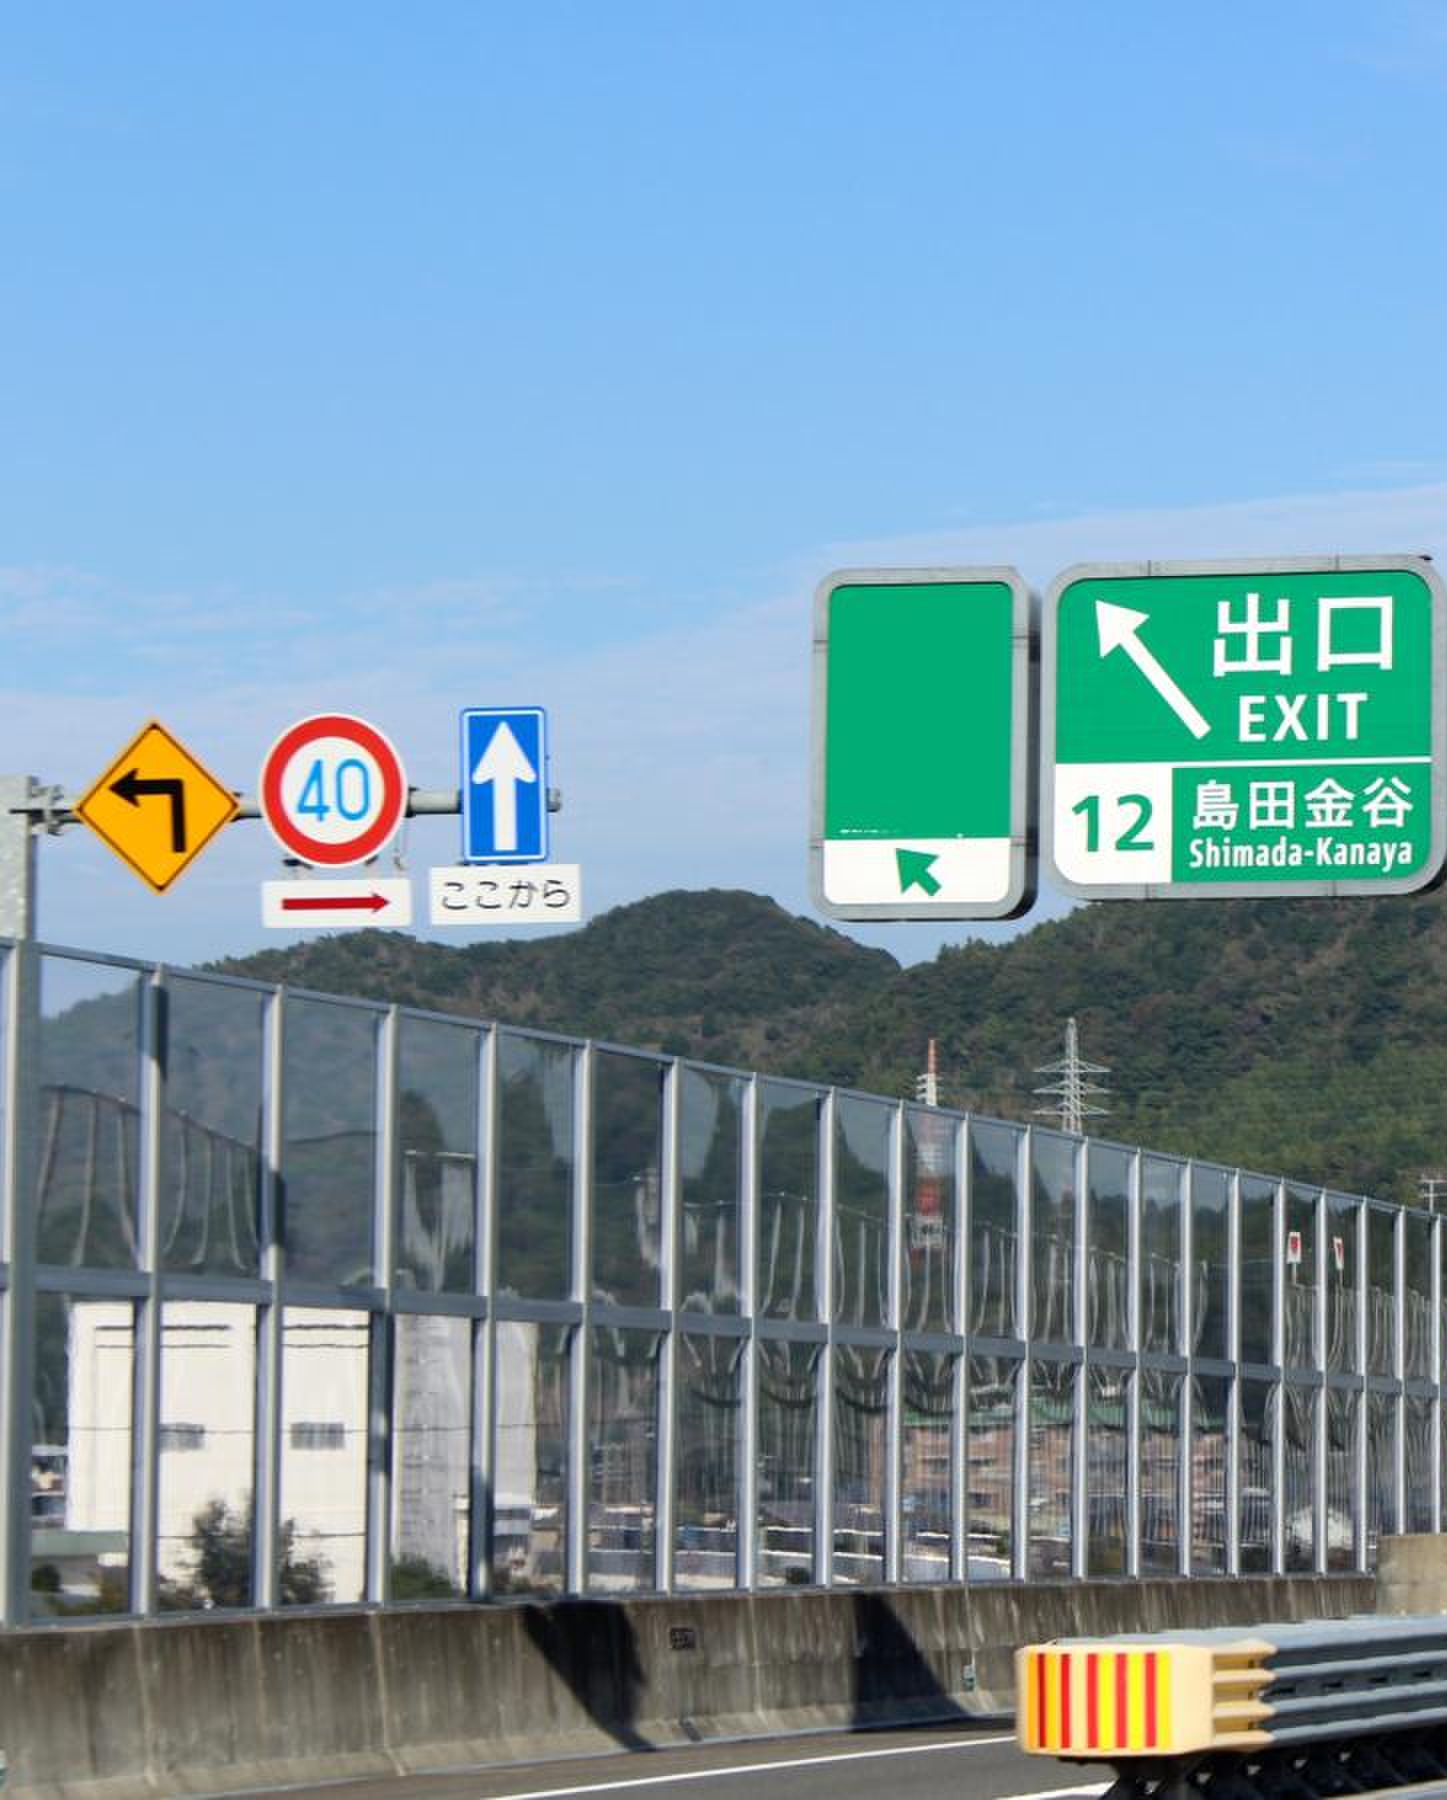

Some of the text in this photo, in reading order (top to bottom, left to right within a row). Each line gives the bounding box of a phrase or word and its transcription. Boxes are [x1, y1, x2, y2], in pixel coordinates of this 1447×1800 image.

[1214, 593, 1393, 677] 出口
[1239, 693, 1367, 742] EXIT
[297, 758, 370, 821] 40
[1194, 777, 1412, 830] 島田金谷
[1072, 794, 1153, 852] 12
[1190, 837, 1413, 872] Shimada-Kanaya
[443, 880, 570, 910] ここから
